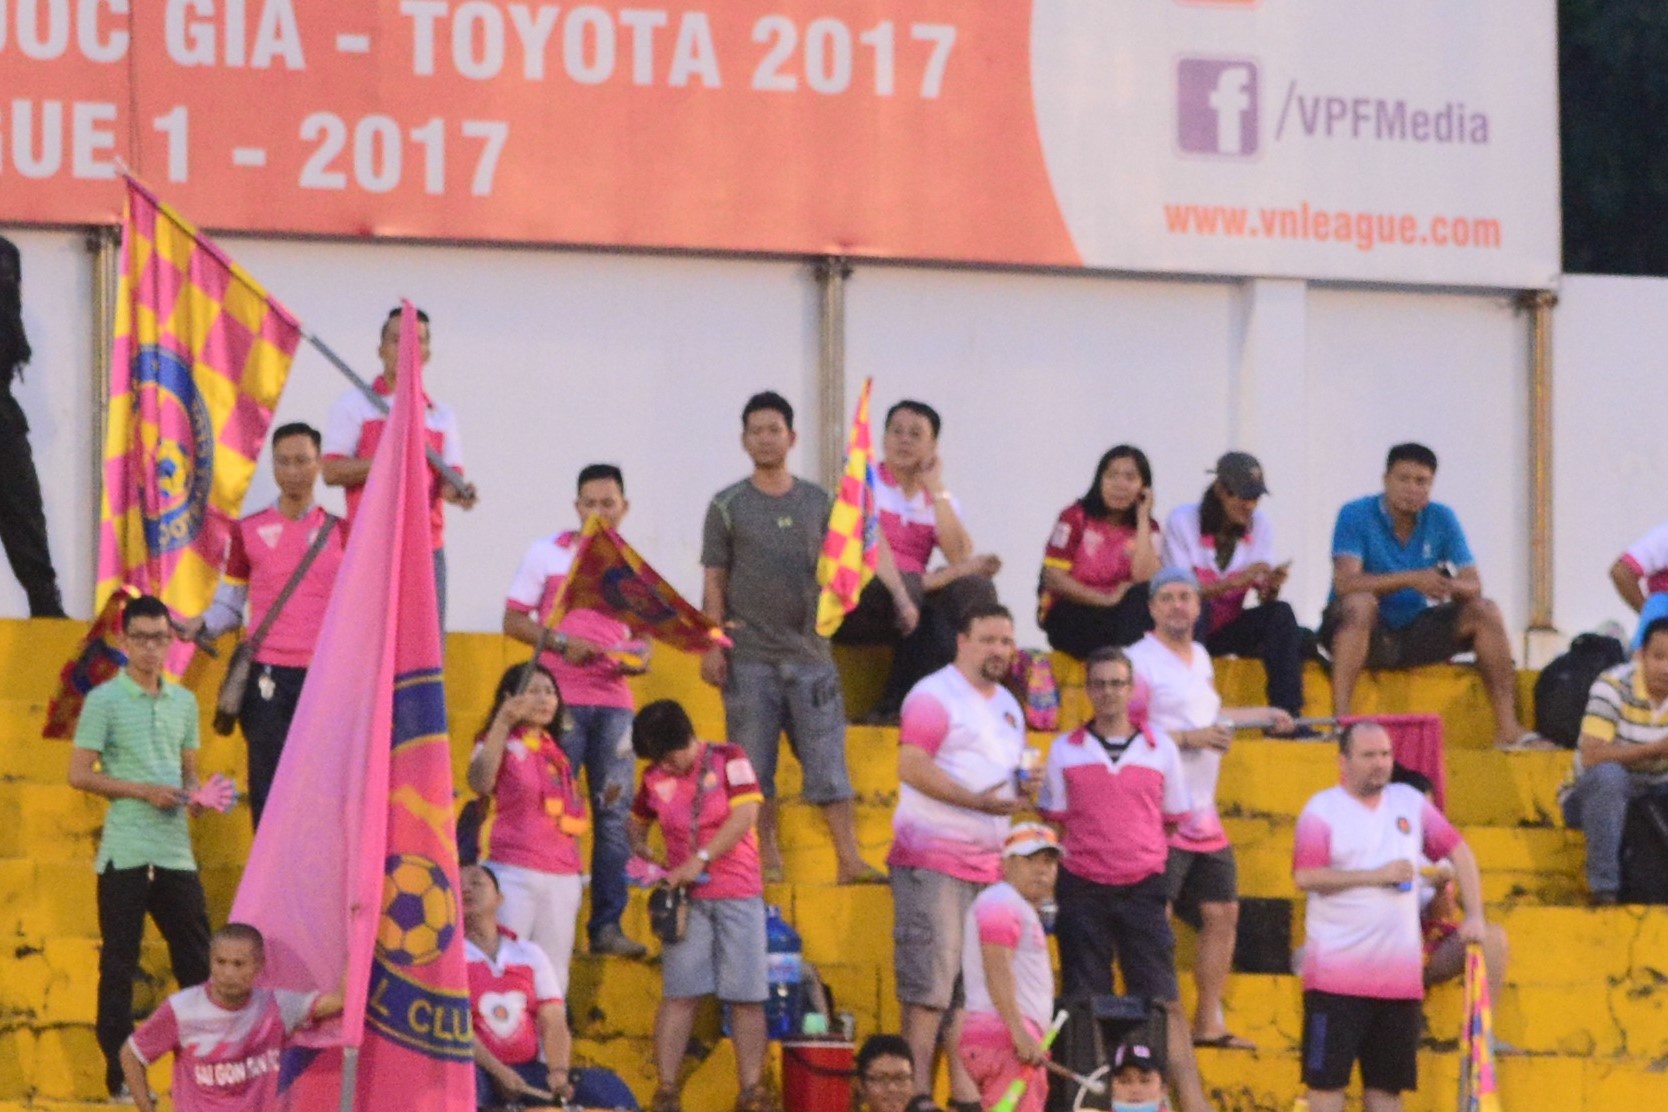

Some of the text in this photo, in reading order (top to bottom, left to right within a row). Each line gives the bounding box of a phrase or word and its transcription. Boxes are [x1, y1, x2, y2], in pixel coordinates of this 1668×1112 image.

[165, 0, 306, 70] GIA
[402, 0, 722, 88] TOYOTA
[750, 15, 957, 98] 2017
[1275, 80, 1490, 144] /VPFMedia
[0, 98, 118, 180] UE
[152, 105, 188, 183] 1
[299, 112, 510, 196] 2017
[1164, 201, 1502, 250] www.vnleague.com
[407, 998, 474, 1043] CLU
